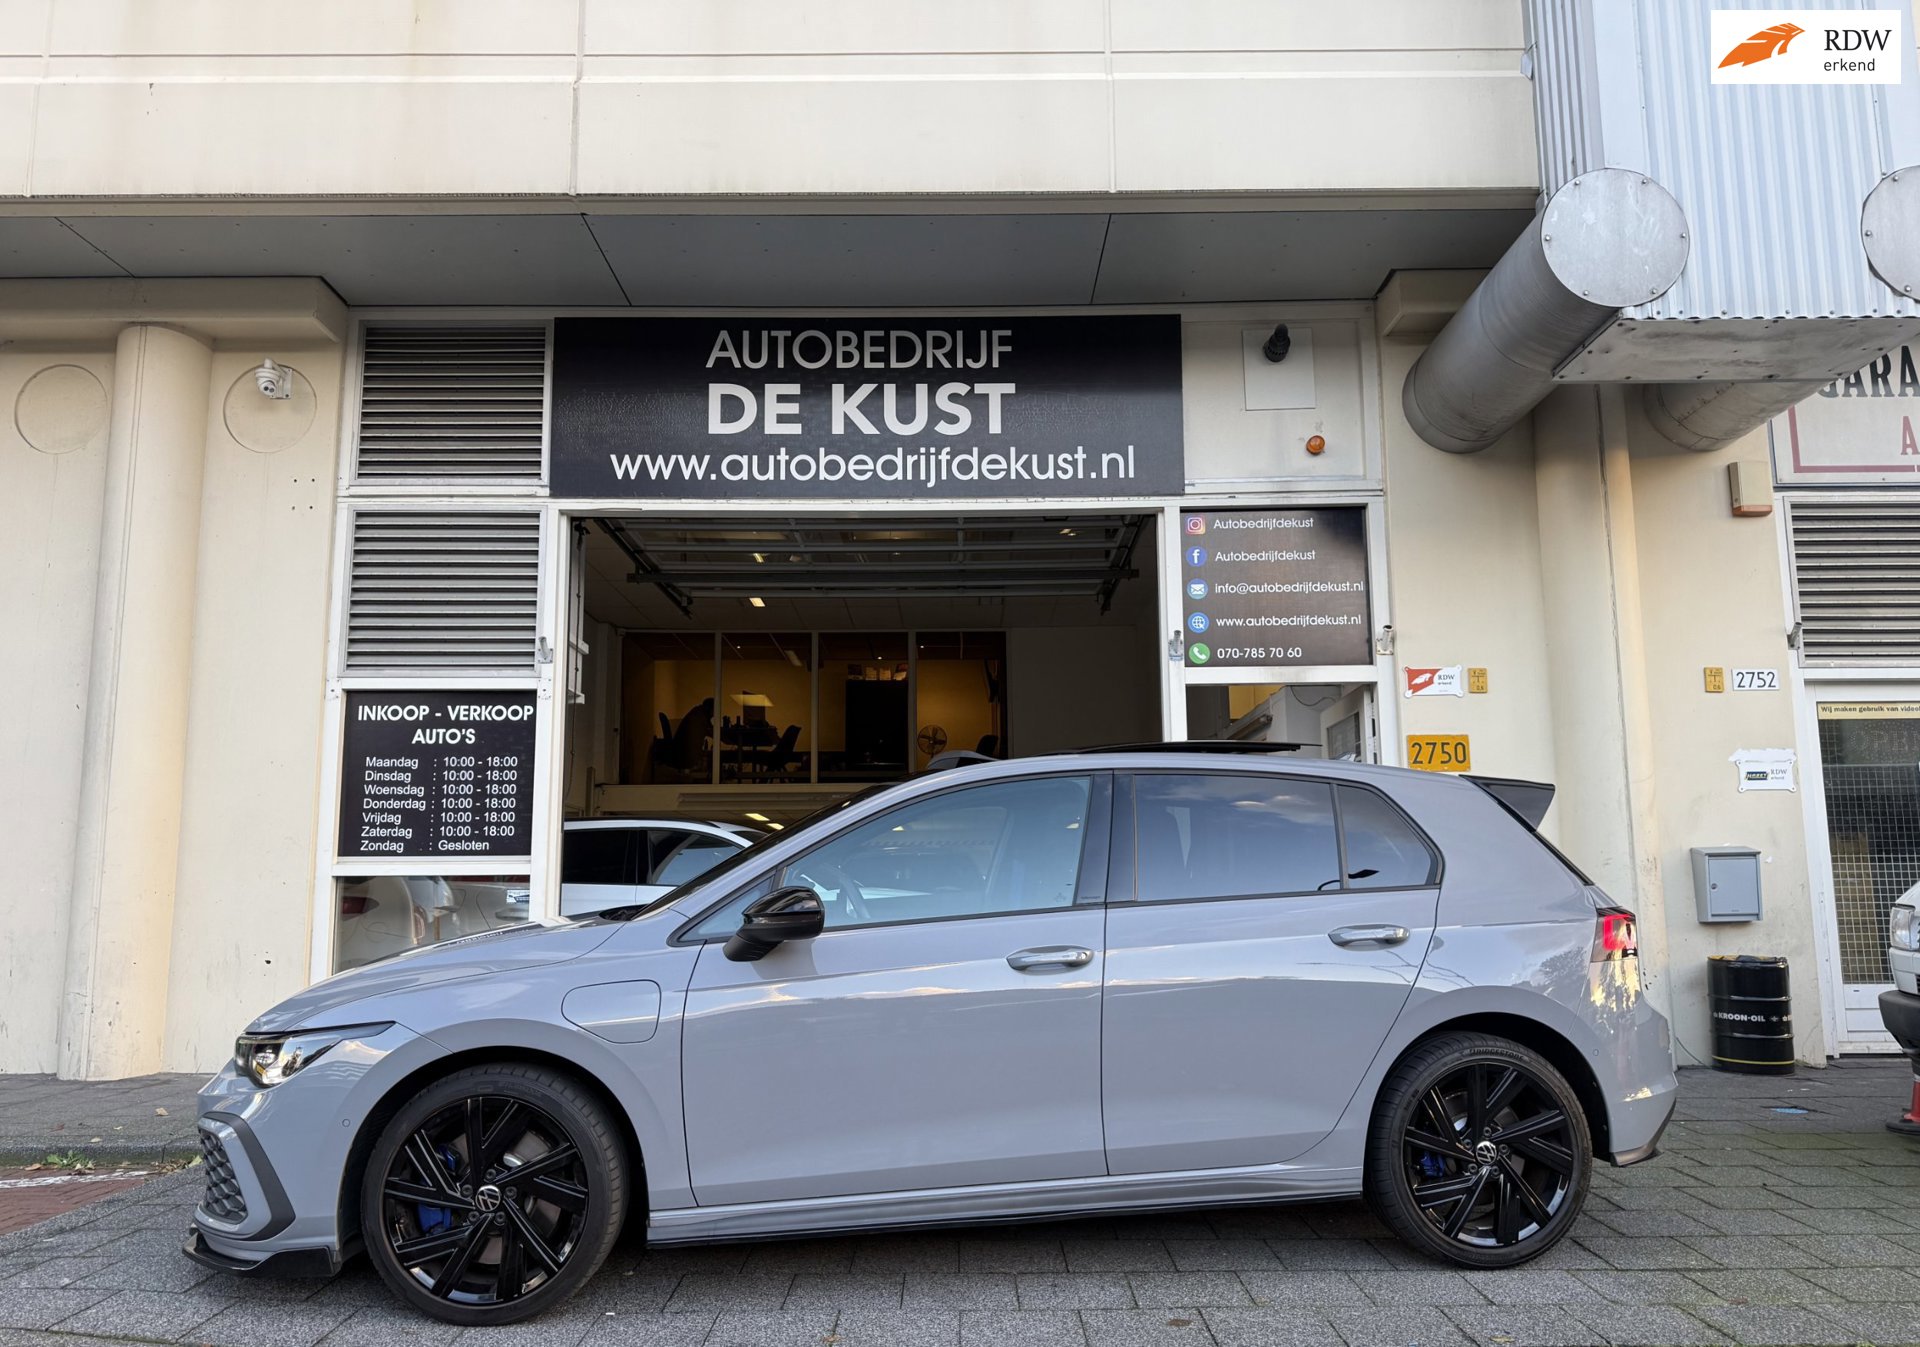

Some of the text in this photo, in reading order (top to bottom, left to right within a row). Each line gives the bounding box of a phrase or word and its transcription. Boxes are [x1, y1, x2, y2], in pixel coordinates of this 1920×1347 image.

[706, 330, 1011, 369] AUTOBEDRIJF
[1819, 346, 1920, 398] ARA
[708, 383, 1015, 435] DE KUST
[610, 445, 1134, 487] www.autobedrijfdekust.nl
[1214, 518, 1313, 530] Autobedrijfdekust
[1215, 550, 1315, 562] Autobedrijfdekust
[1216, 581, 1363, 594] info@autobedrijfdekust.nl
[1216, 615, 1361, 627] www.autobedrijfdekust.nl
[1217, 647, 1301, 658] 070-785 70 60
[1737, 672, 1776, 688] 2752
[358, 705, 429, 720] INKOOP
[448, 705, 534, 721] VERKOOP
[1858, 706, 1884, 714] gebruik
[412, 729, 475, 744] AUTO'S
[1412, 742, 1466, 764] 2750
[366, 757, 418, 769] Maandag
[444, 757, 474, 766] 10:00
[487, 757, 517, 766] 18:00
[365, 771, 411, 783] Dinsdag
[443, 770, 474, 780] 10:00
[486, 770, 517, 780] 18:00
[364, 785, 424, 797] Woensdag
[443, 784, 473, 794] 10:00
[486, 784, 516, 794] 18:00
[364, 798, 426, 811] Donderdag
[442, 798, 472, 808] 10:00
[485, 798, 515, 808] 18:00
[362, 812, 401, 825] Vrijdag
[441, 812, 471, 822] 10:00
[484, 812, 515, 822] 18:00
[361, 826, 412, 839] Zaterdag
[440, 826, 471, 836] 10:00
[484, 826, 514, 836] 18:00
[360, 840, 403, 853] Zondag
[438, 840, 489, 850] Gesloten
[1719, 1012, 1765, 1022] KROON-OIL
